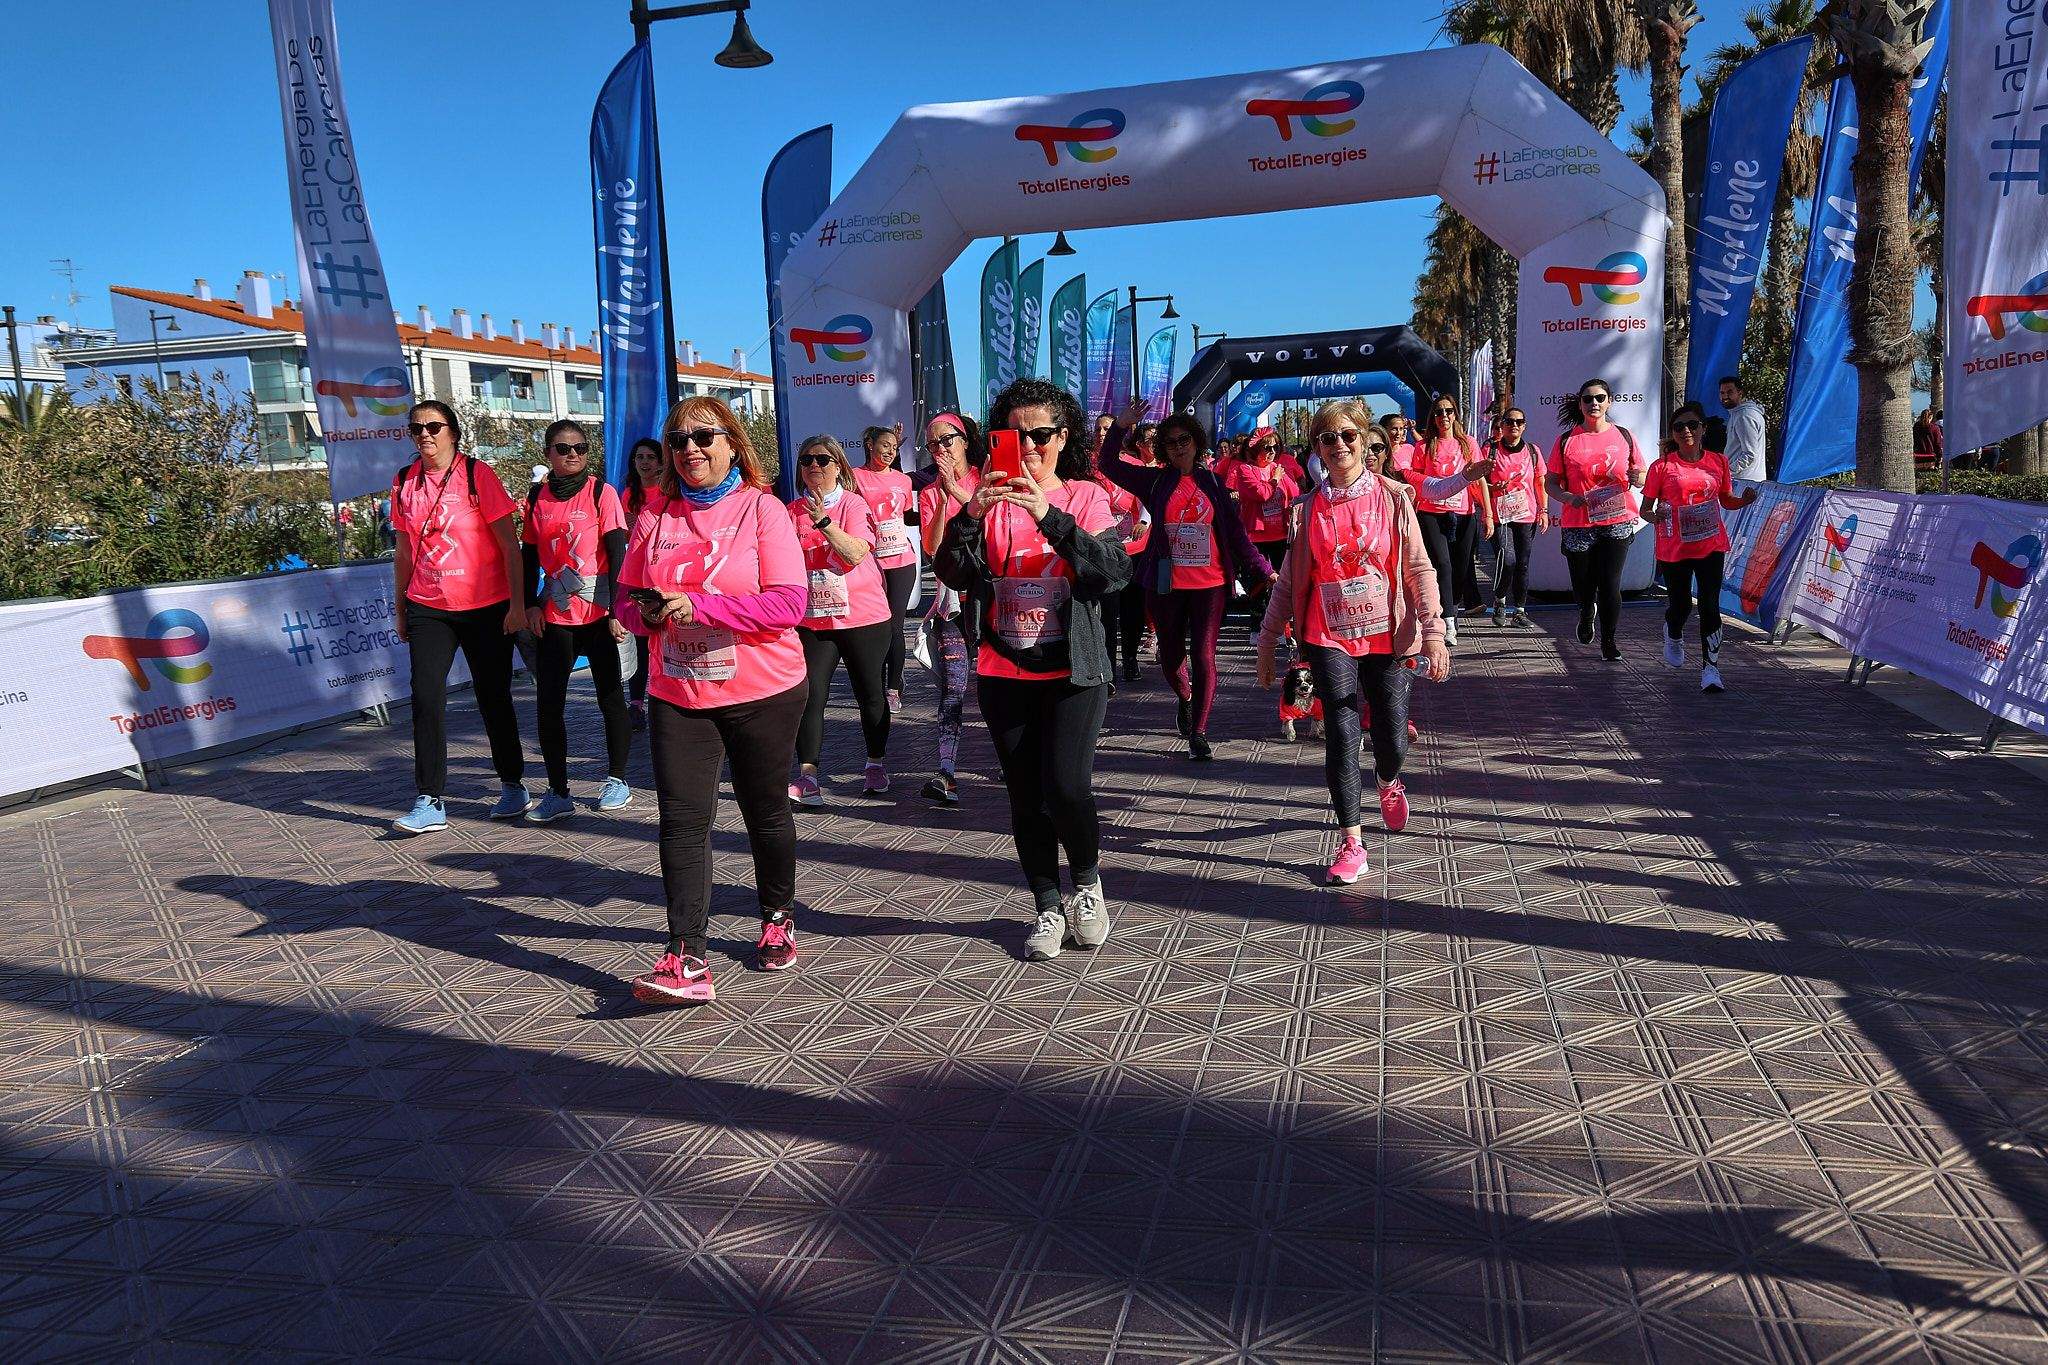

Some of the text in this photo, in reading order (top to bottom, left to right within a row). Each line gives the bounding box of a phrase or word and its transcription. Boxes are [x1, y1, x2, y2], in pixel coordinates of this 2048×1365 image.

[308, 35, 370, 244] LasCarreras
[1248, 147, 1367, 173] TotalEnergies
[1503, 162, 1600, 182] LasCarreras
[1018, 173, 1130, 195] TotalEnergies
[840, 229, 923, 244] LasCarreras
[1696, 160, 1767, 316] Marlene
[600, 177, 659, 353] Marlene
[1541, 315, 1646, 334] TotalEnergies
[1246, 343, 1375, 364] VOLVO
[792, 372, 875, 389] TotalEnergies
[1300, 373, 1357, 394] Marlene
[323, 424, 412, 443] TotalEnergie
[1180, 542, 1198, 550] 016
[811, 590, 831, 600] 016
[1018, 610, 1046, 622] 016
[1348, 602, 1374, 616] 016
[316, 628, 405, 660] LasCarrera
[678, 641, 708, 654] 016
[1946, 621, 2009, 662] TotalEnergies
[327, 665, 396, 688] totalenergies.es
[110, 695, 237, 735] TotalEnergies
